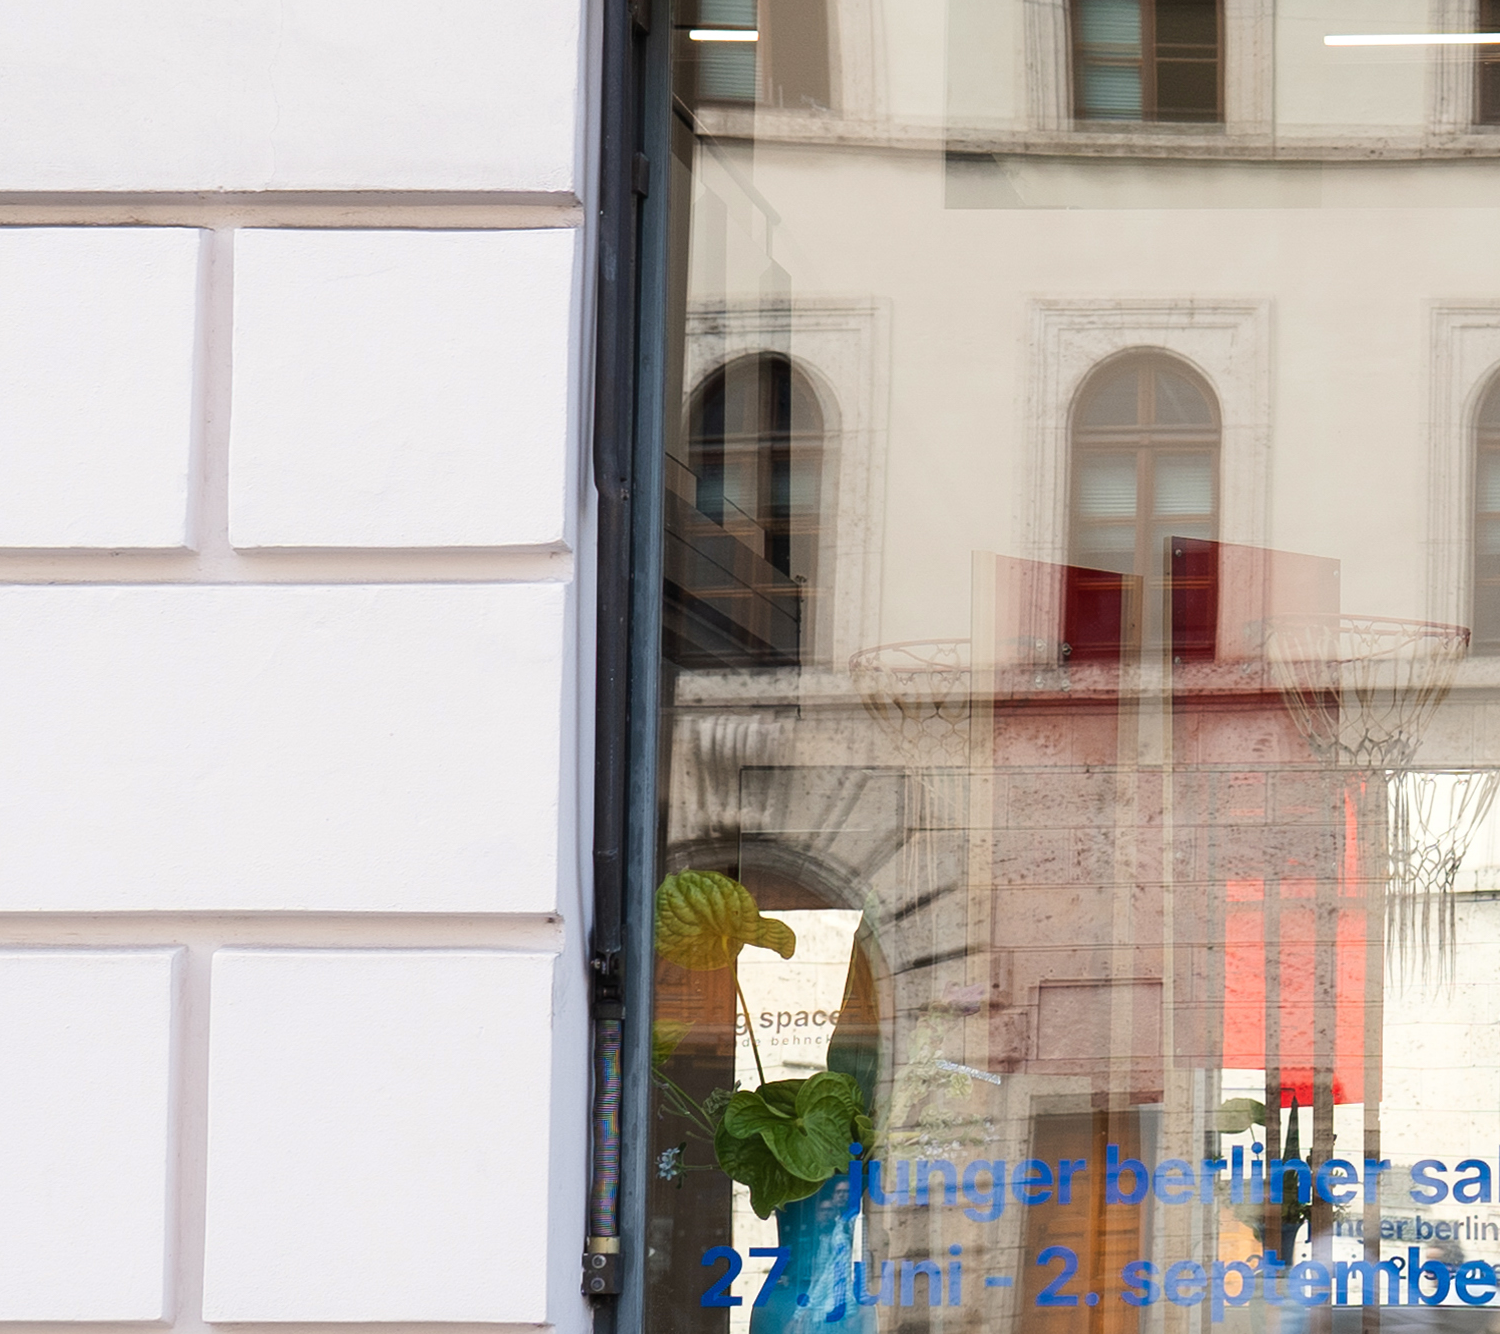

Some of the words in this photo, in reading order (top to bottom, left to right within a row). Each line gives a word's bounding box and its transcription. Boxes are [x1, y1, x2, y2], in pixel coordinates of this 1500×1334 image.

[843, 1141, 1087, 1223] junger
[1105, 1142, 1392, 1207] berliner
[699, 1244, 811, 1309] 27.
[825, 1243, 963, 1323] juni
[1035, 1245, 1100, 1309] 2.
